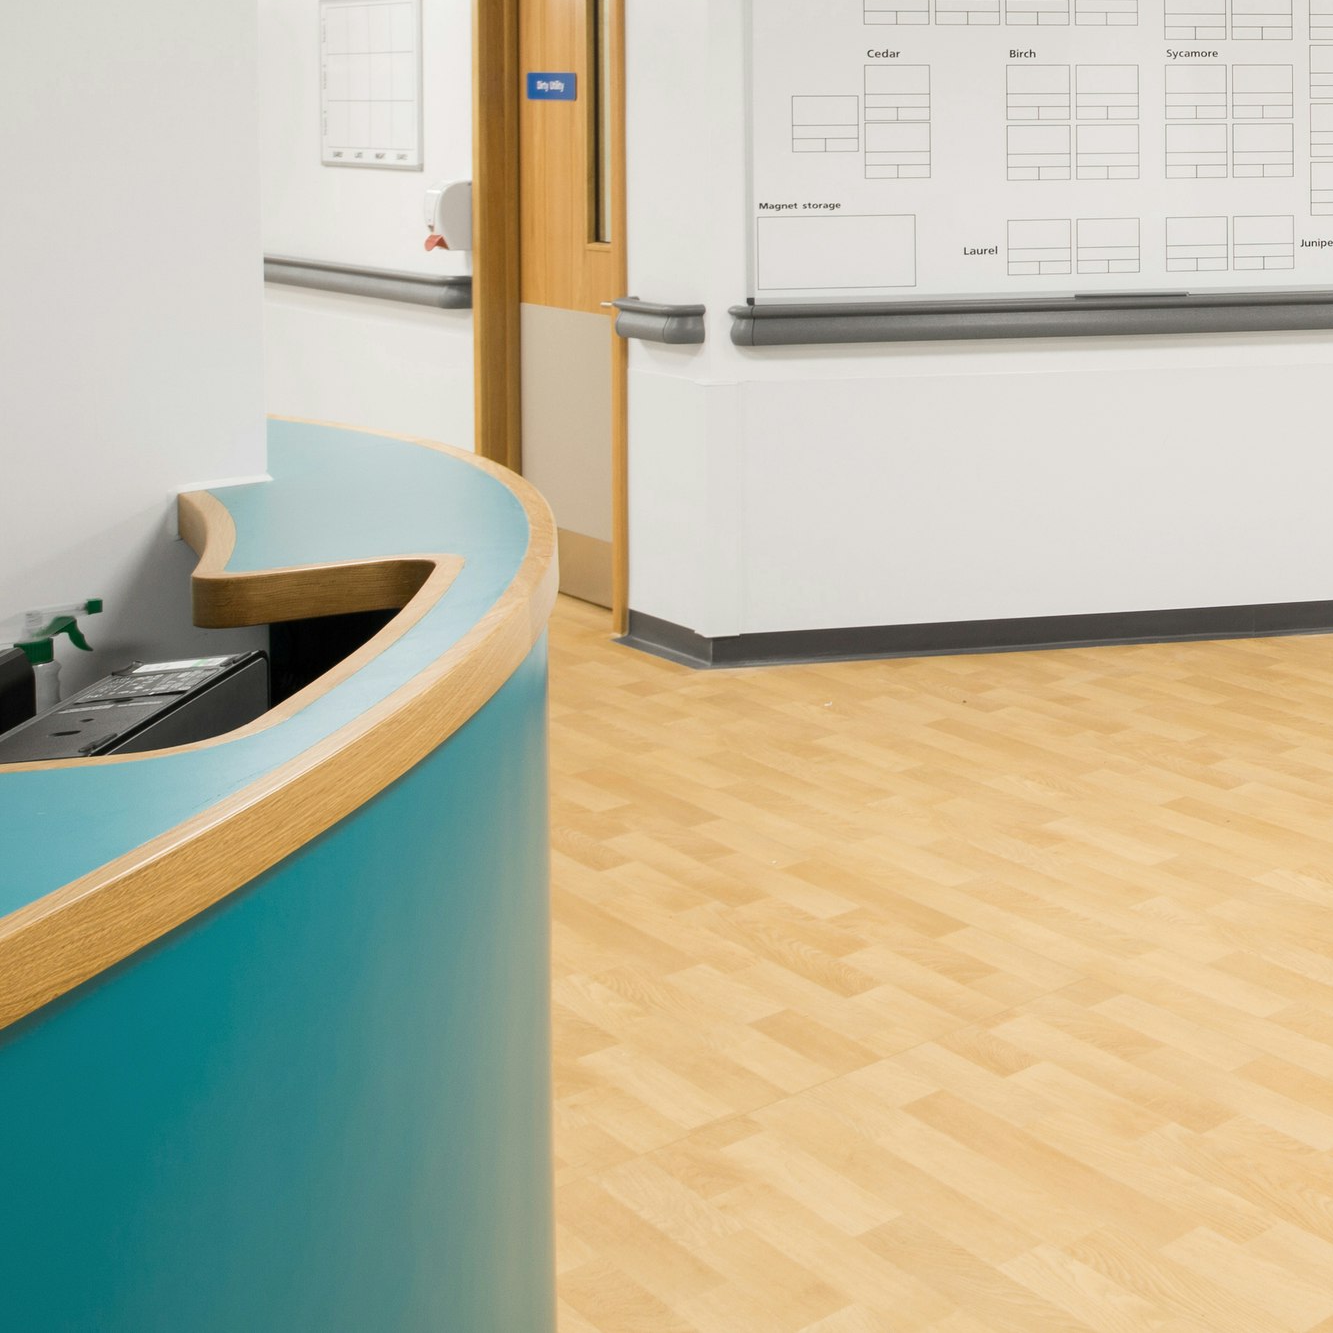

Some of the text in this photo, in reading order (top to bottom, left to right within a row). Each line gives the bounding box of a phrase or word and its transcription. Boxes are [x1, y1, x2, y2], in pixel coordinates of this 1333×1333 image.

[866, 48, 901, 59] Cedar
[1009, 48, 1037, 59] Birch
[1166, 48, 1219, 60] Sycamore
[758, 202, 842, 212] Magnet storage
[963, 245, 998, 256] Laurel
